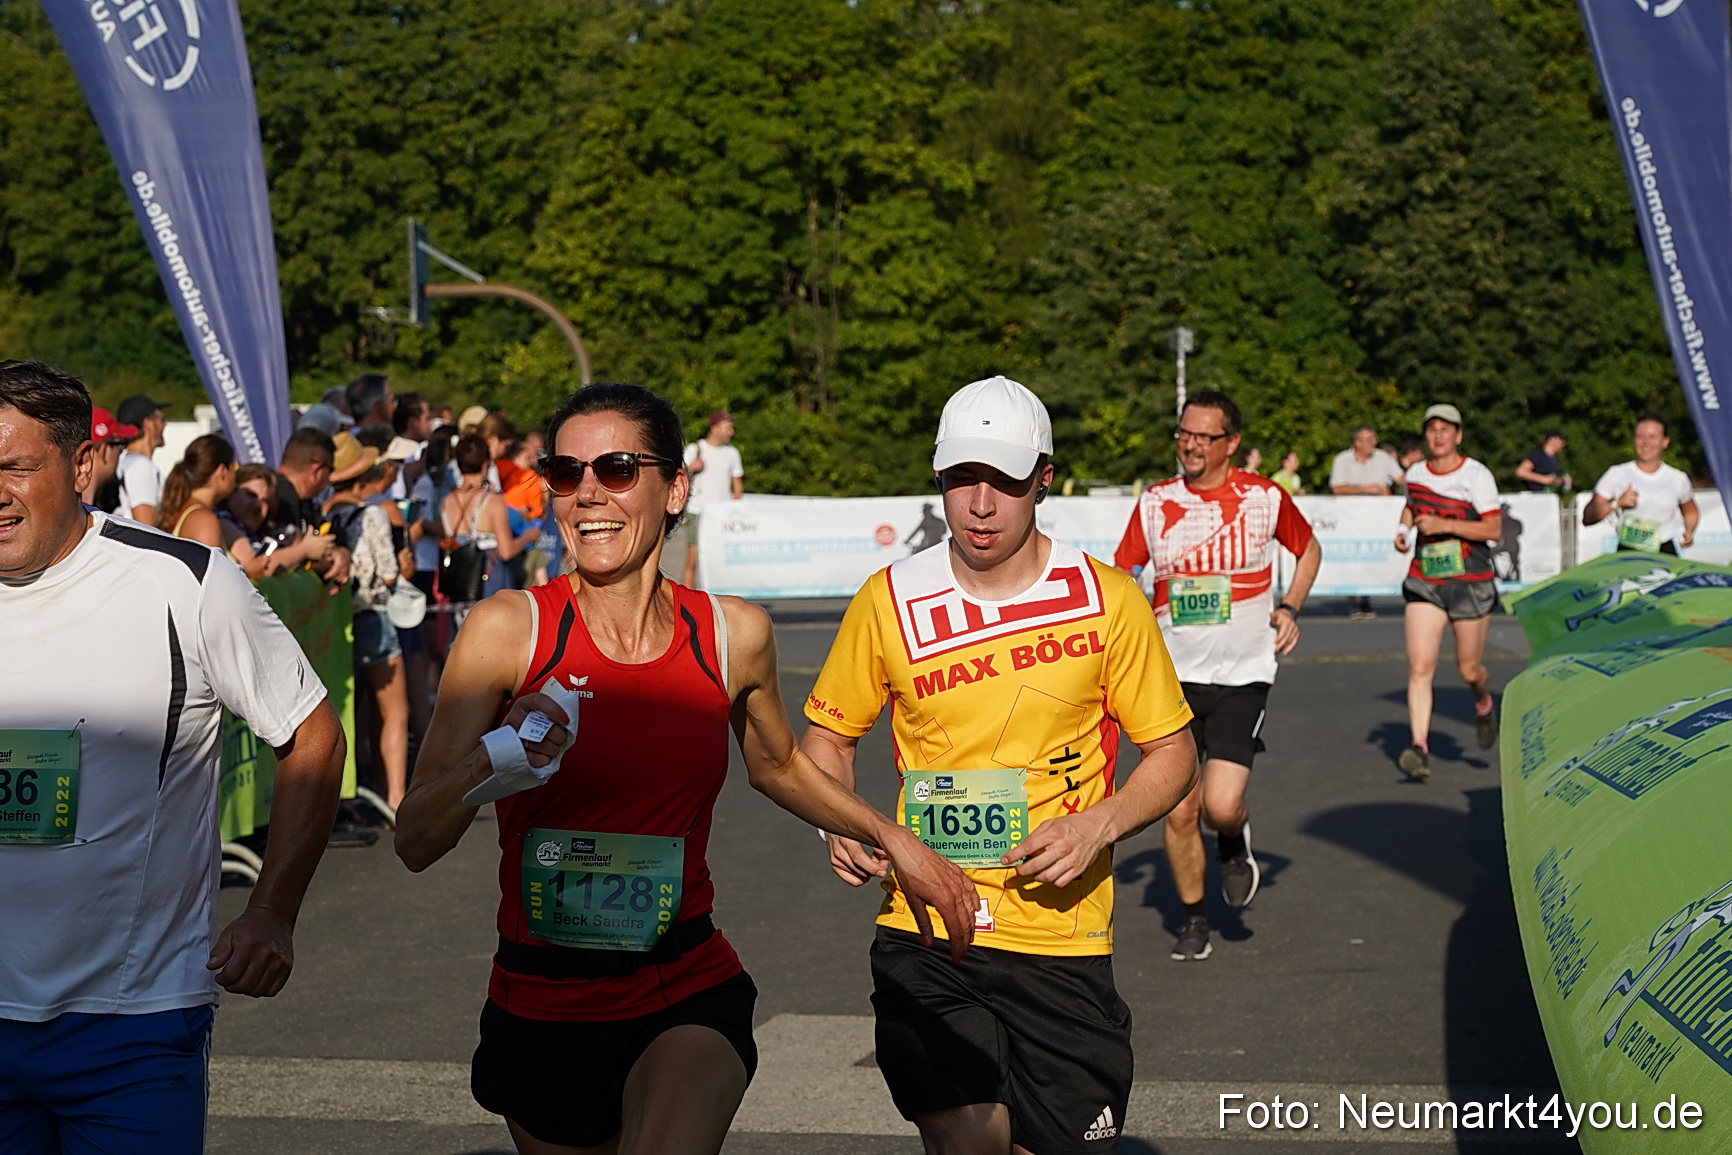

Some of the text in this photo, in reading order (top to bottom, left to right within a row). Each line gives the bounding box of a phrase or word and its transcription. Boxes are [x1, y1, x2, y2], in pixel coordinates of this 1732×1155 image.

[1179, 593, 1220, 610] 1098
[1010, 630, 1105, 671] BÖGL
[911, 653, 1001, 700] MAX
[55, 776, 70, 828] 2022
[931, 787, 968, 797] Firmenlauf
[911, 815, 921, 836] UN
[922, 804, 1007, 836] 1636
[563, 852, 613, 862] Firmenlauf
[922, 839, 1008, 850] Sauerwein Ben
[530, 881, 543, 920] RUN
[548, 871, 654, 913] 1128
[553, 912, 644, 929] Beck Sandra
[657, 883, 673, 936] 2022
[1617, 1021, 1684, 1085] neumarkt
[1084, 1125, 1117, 1141] adidas
